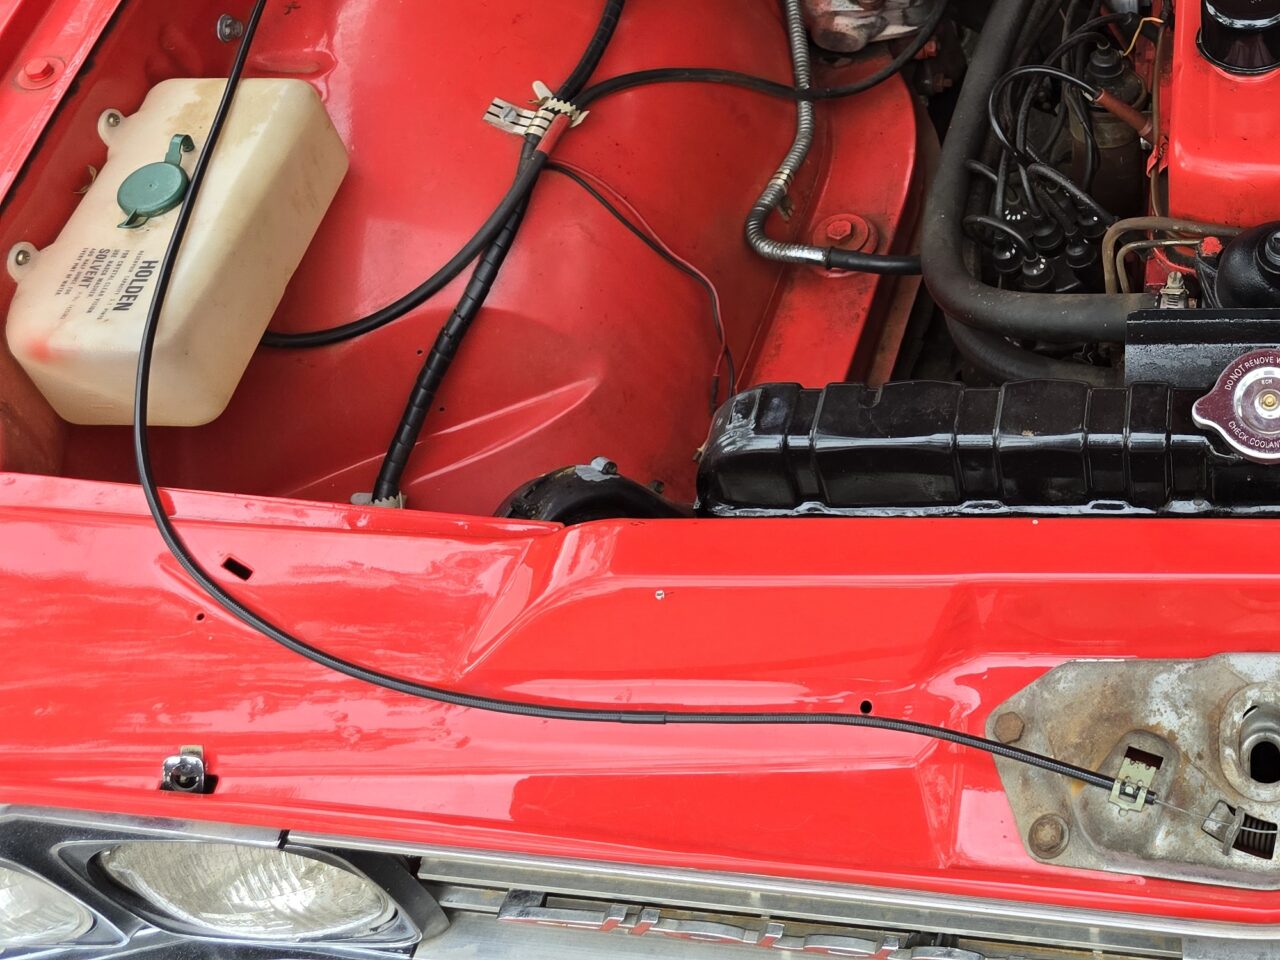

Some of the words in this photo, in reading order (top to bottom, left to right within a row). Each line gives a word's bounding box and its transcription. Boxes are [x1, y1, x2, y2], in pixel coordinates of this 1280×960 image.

[77, 248, 89, 261] EVERY
[87, 248, 96, 257] ADD
[111, 249, 120, 258] USE
[120, 250, 130, 259] FOR
[70, 262, 79, 272] PINT
[78, 248, 111, 289] SOLVENT
[80, 258, 89, 269] HALF
[107, 260, 124, 281] CRYSTAL
[70, 271, 82, 285] OUNCE
[98, 282, 111, 297] CLEAR
[112, 260, 159, 311] HOLDEN
[1224, 378, 1234, 391] DO
[1231, 364, 1246, 380] NOT
[1245, 356, 1275, 369] REMOVE
[1228, 420, 1248, 442] CHECK
